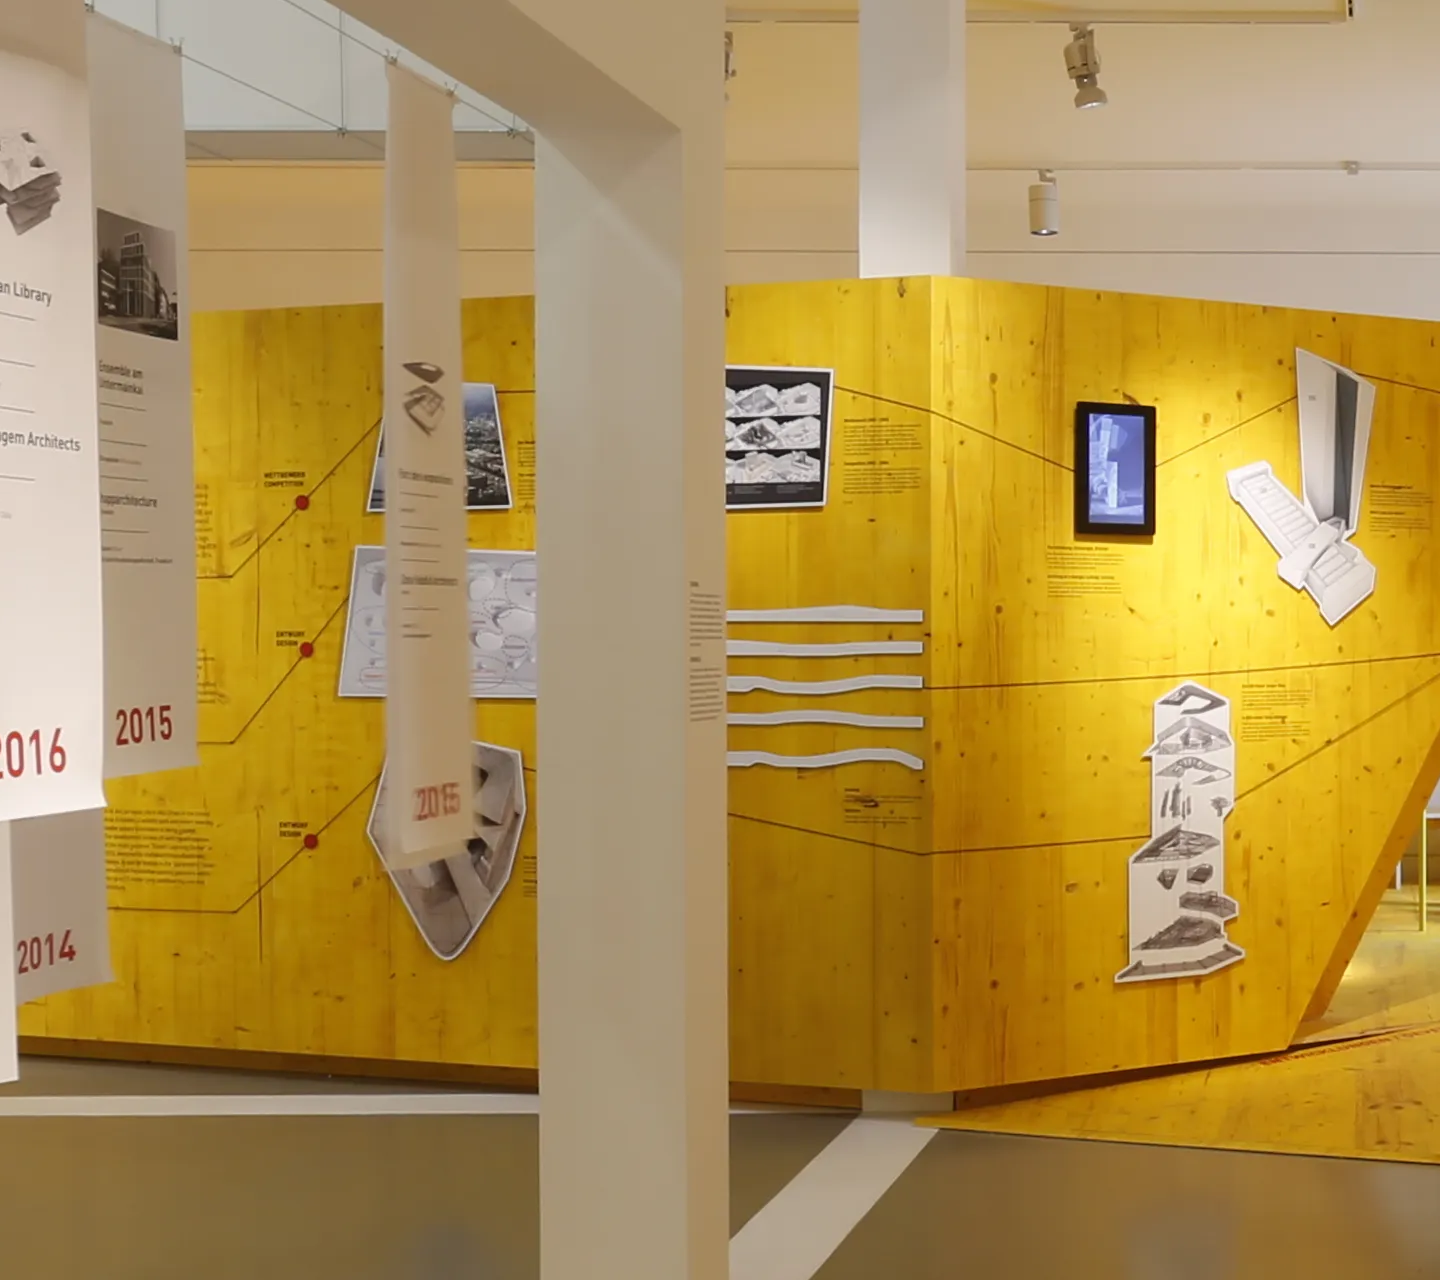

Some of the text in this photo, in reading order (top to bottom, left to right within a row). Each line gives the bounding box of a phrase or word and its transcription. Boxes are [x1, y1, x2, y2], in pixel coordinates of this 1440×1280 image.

[13, 281, 53, 307] Library
[27, 431, 82, 452] Architects
[115, 705, 173, 747] 2015
[16, 929, 77, 976] 2014
